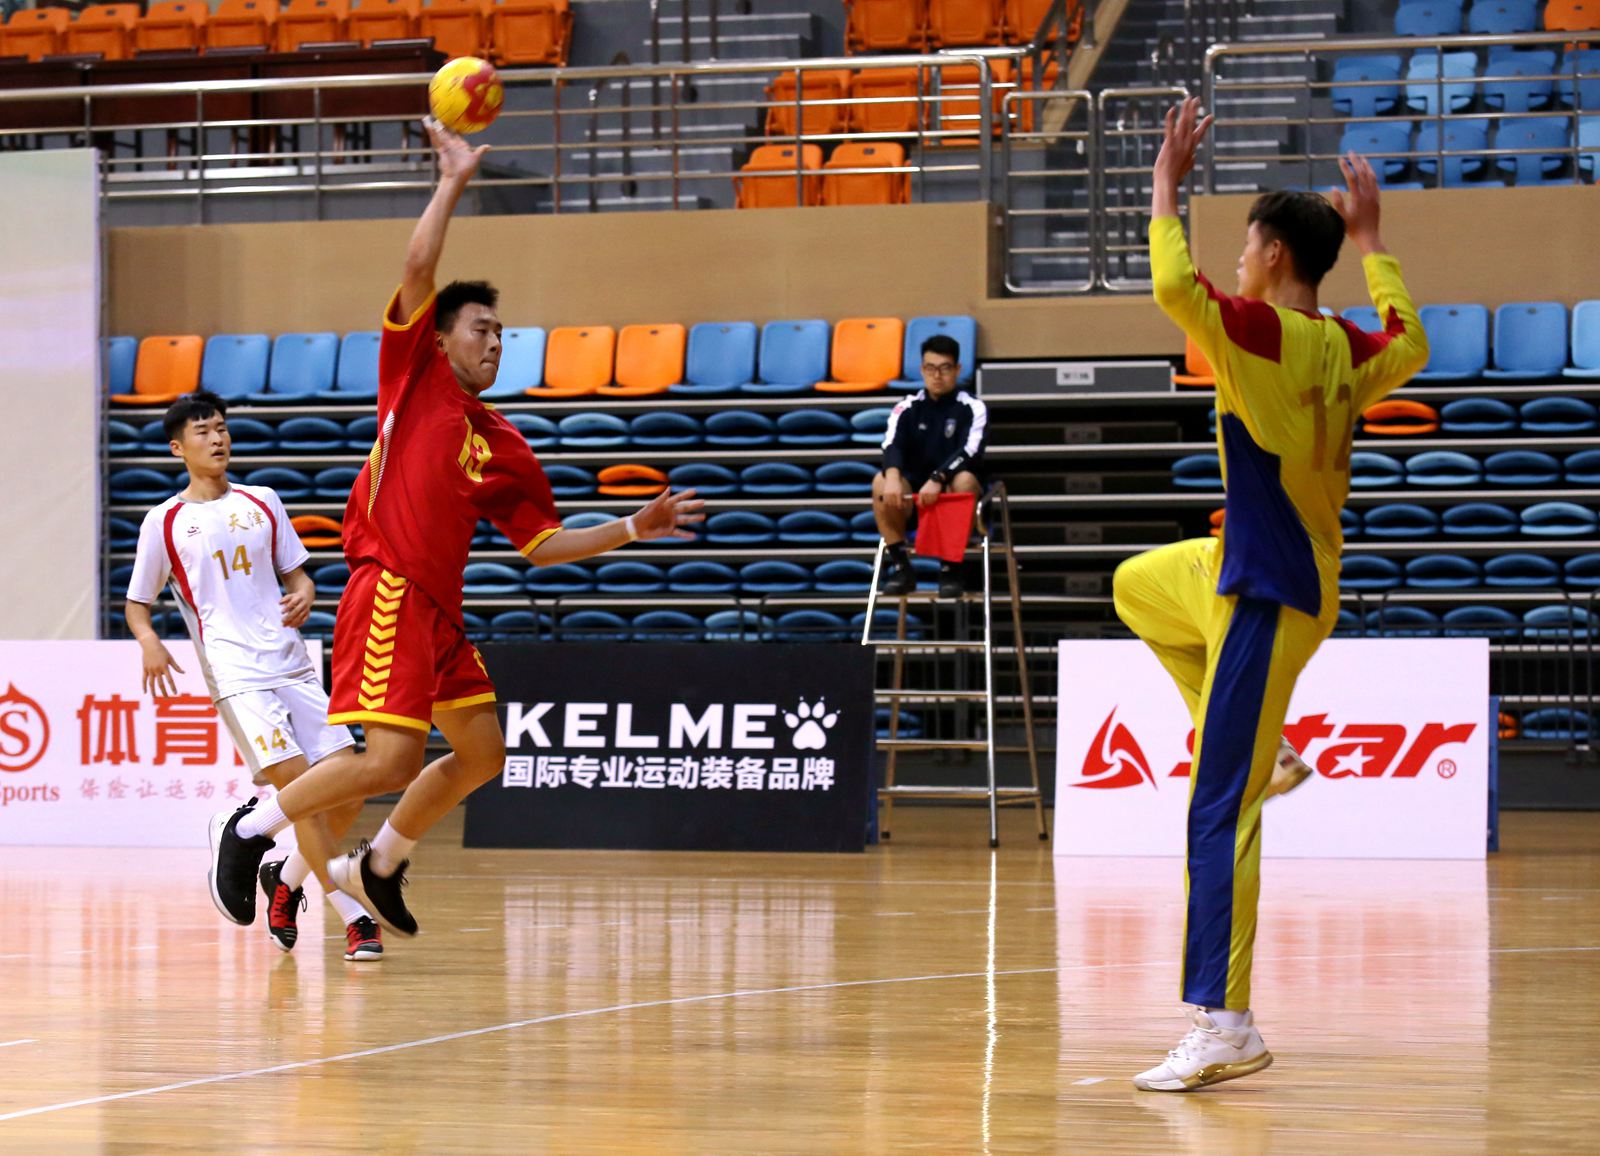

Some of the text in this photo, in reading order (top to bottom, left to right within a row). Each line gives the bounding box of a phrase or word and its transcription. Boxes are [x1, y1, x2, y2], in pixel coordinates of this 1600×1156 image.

[458, 415, 492, 483] 13
[229, 510, 264, 533] 天津
[212, 545, 252, 580] 14
[77, 694, 246, 766] 体育
[255, 728, 287, 756] 14
[505, 703, 777, 749] KELME
[1168, 713, 1477, 779] tar
[503, 755, 835, 791] 国际专业运动装备品牌
[0, 783, 60, 806] ports
